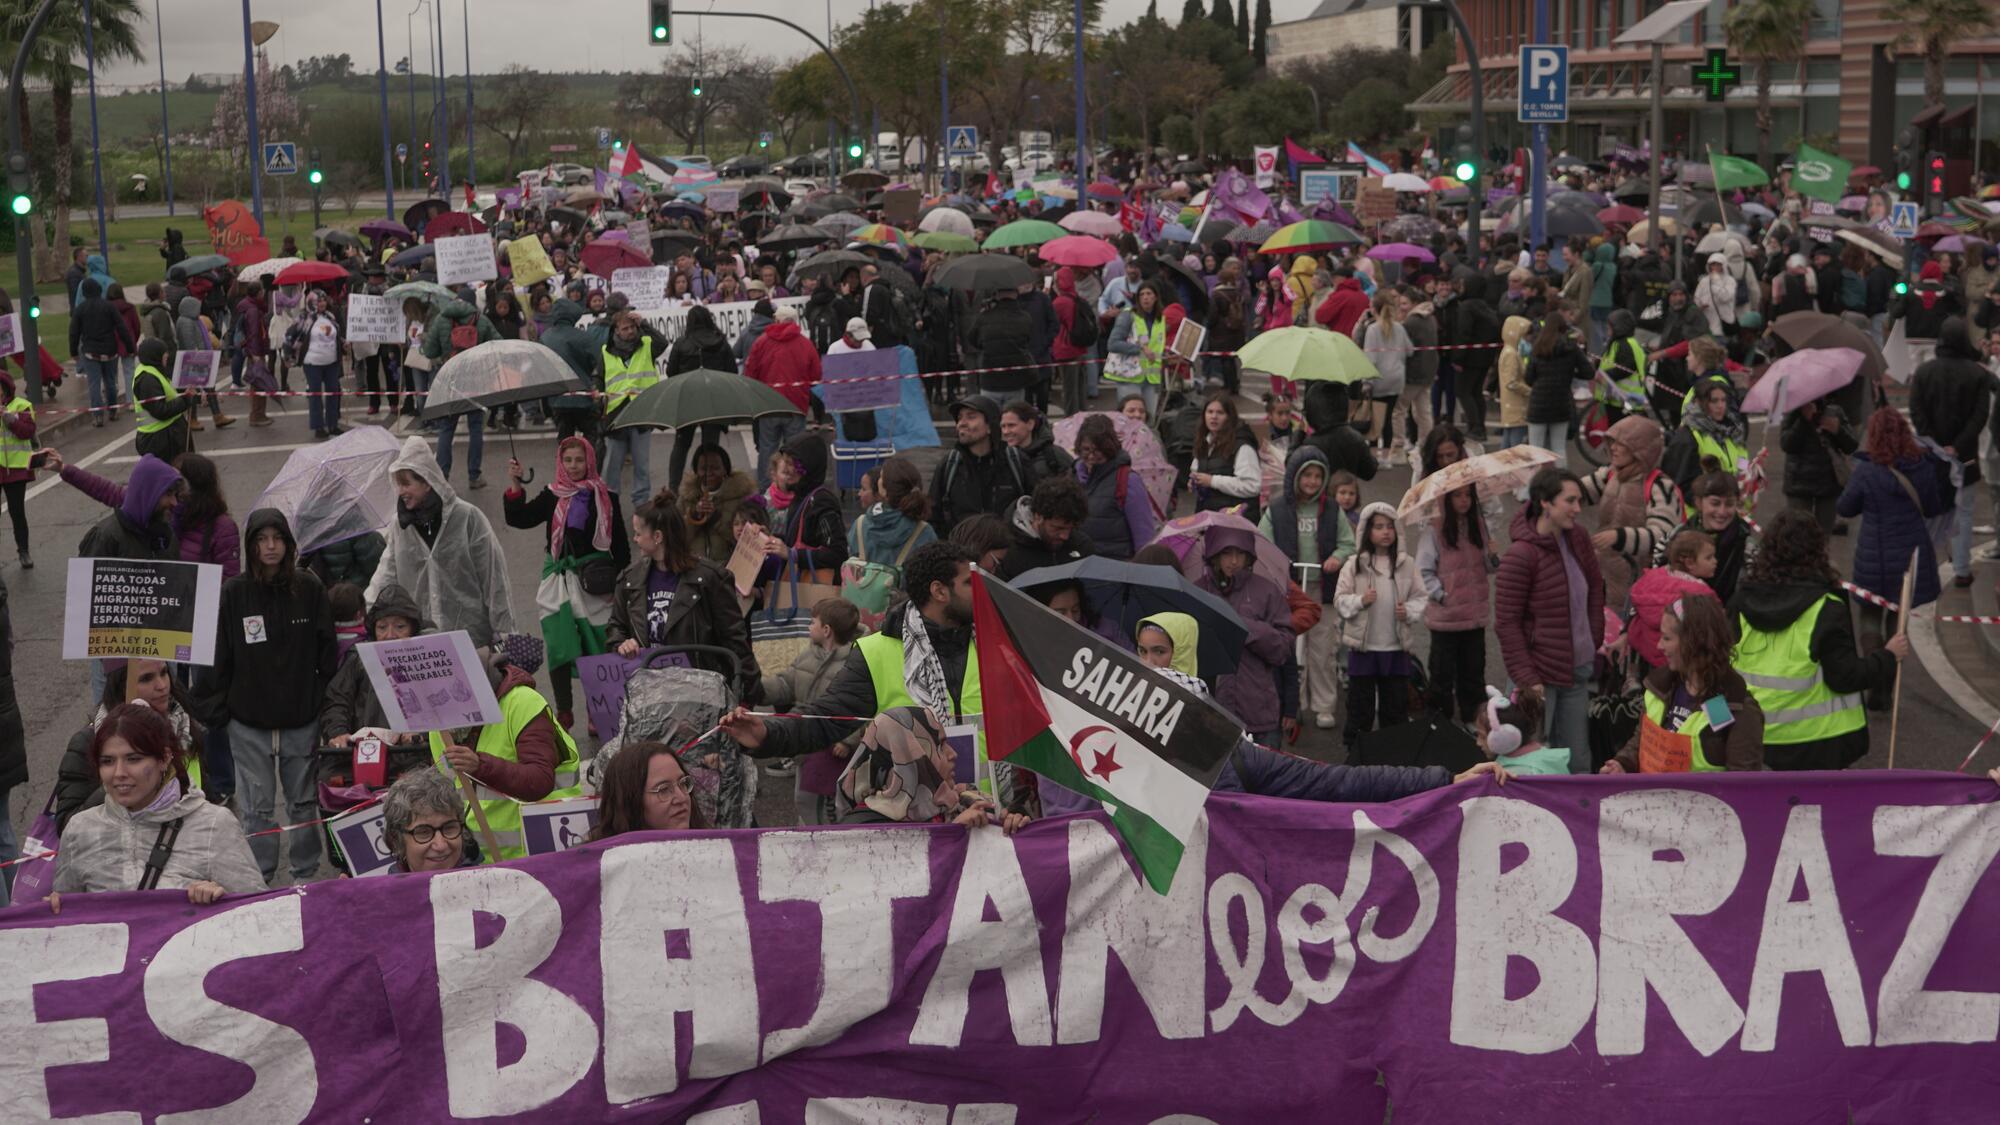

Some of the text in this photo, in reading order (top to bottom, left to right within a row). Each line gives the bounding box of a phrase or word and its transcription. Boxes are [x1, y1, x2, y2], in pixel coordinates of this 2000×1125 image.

[1530, 49, 1560, 90] P
[1540, 103, 1564, 111] TORRE
[95, 574, 167, 585] PARA TODAS
[94, 585, 154, 595] PERSONAS
[94, 595, 181, 607] MIGRANTES DEL
[93, 605, 159, 615] TERRITORIO
[92, 613, 144, 625] ESPAÑOL
[88, 636, 158, 646] DE LA LEY DE
[88, 646, 160, 656] EXTRANJERÍA
[387, 649, 447, 664] PRECARIZADO
[391, 663, 414, 673] PARA
[414, 661, 432, 672] LAS
[1062, 647, 1185, 747] SAHARA
[430, 809, 1208, 1118] BAJAN
[1208, 809, 1441, 1034] los
